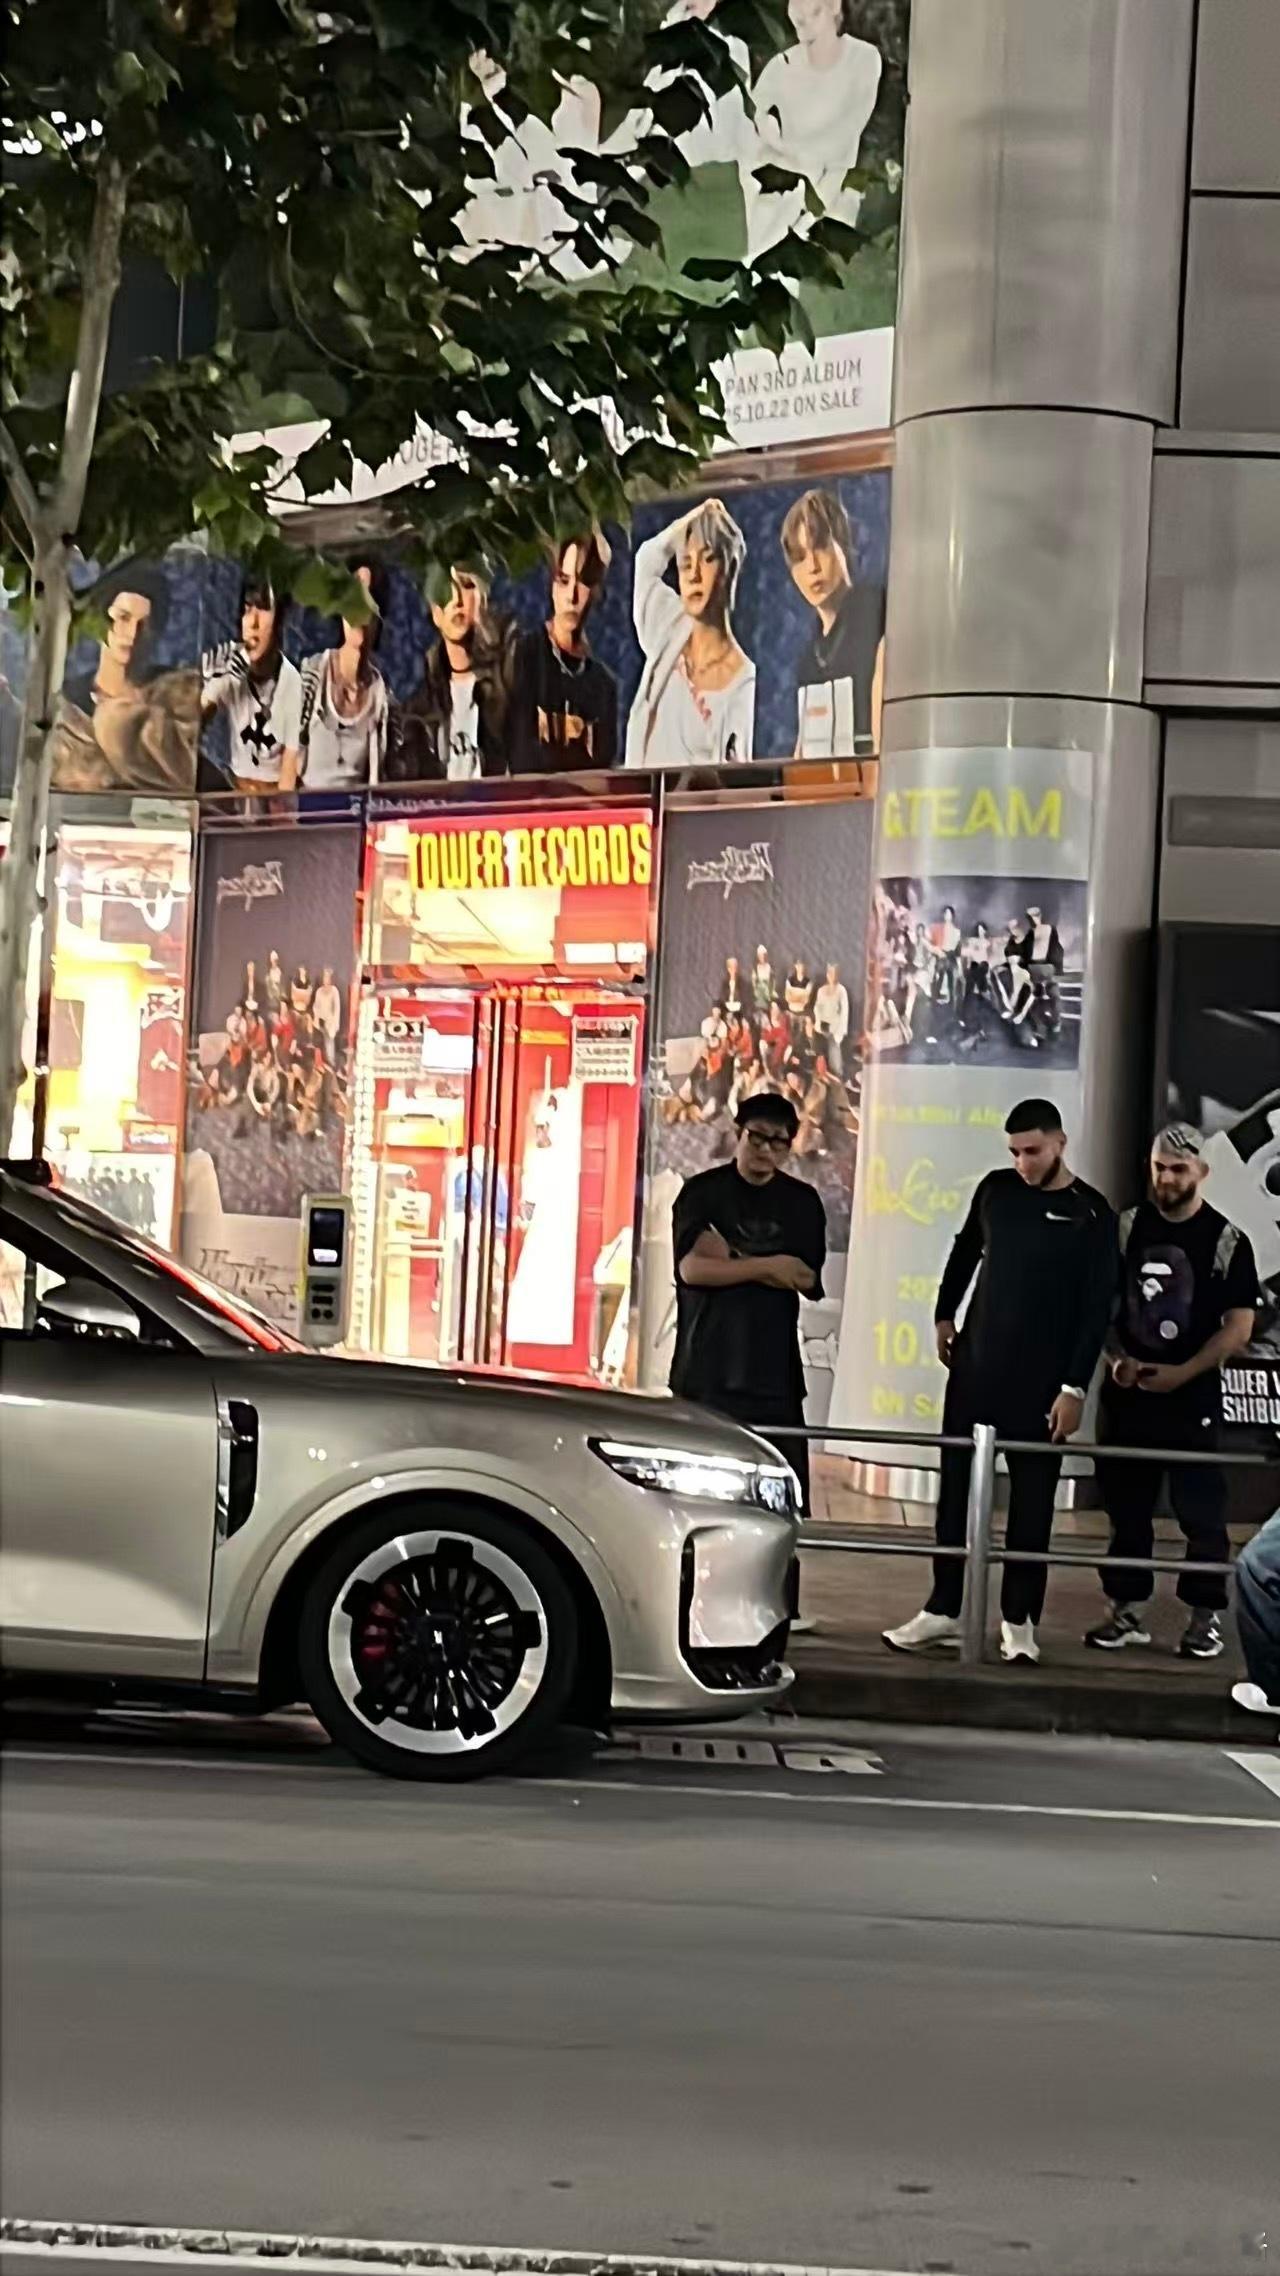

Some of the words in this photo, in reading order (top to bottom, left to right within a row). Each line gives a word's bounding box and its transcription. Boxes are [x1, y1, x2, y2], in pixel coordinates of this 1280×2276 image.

[802, 358, 861, 384] ALBUM
[794, 395, 816, 416] ON
[820, 387, 859, 411] SALE
[408, 830, 504, 890] TOWER
[508, 823, 652, 888] RECORDS
